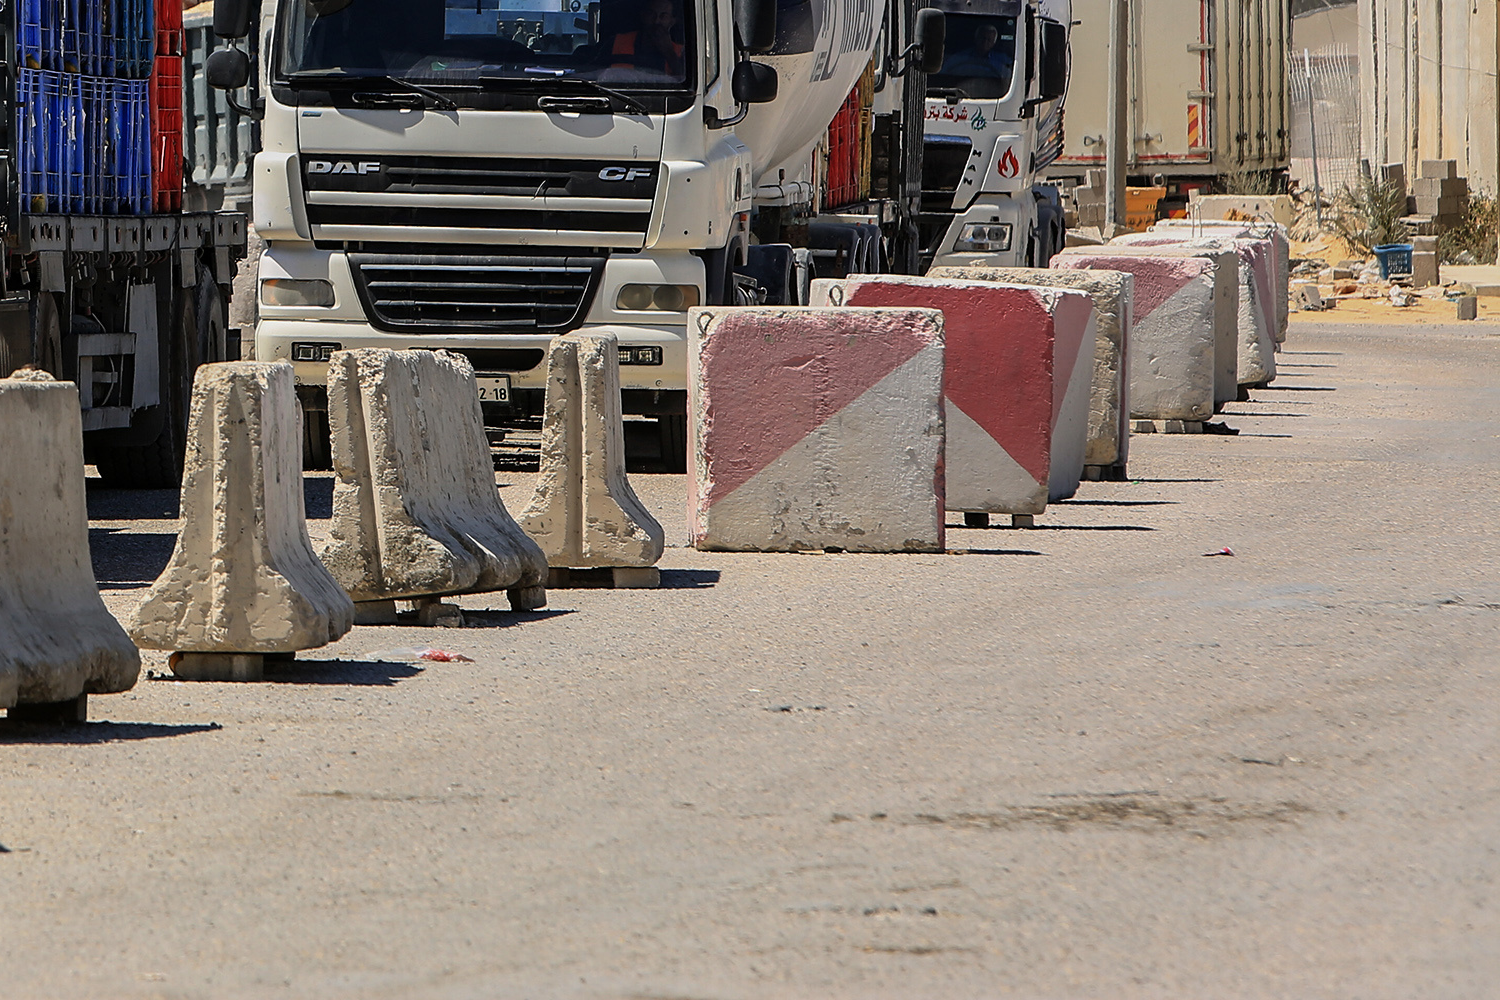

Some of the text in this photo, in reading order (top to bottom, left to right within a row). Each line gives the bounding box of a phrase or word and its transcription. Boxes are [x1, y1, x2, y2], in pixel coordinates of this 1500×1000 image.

[308, 160, 381, 175] DAF
[598, 166, 653, 181] CF
[479, 387, 507, 401] 2-18
